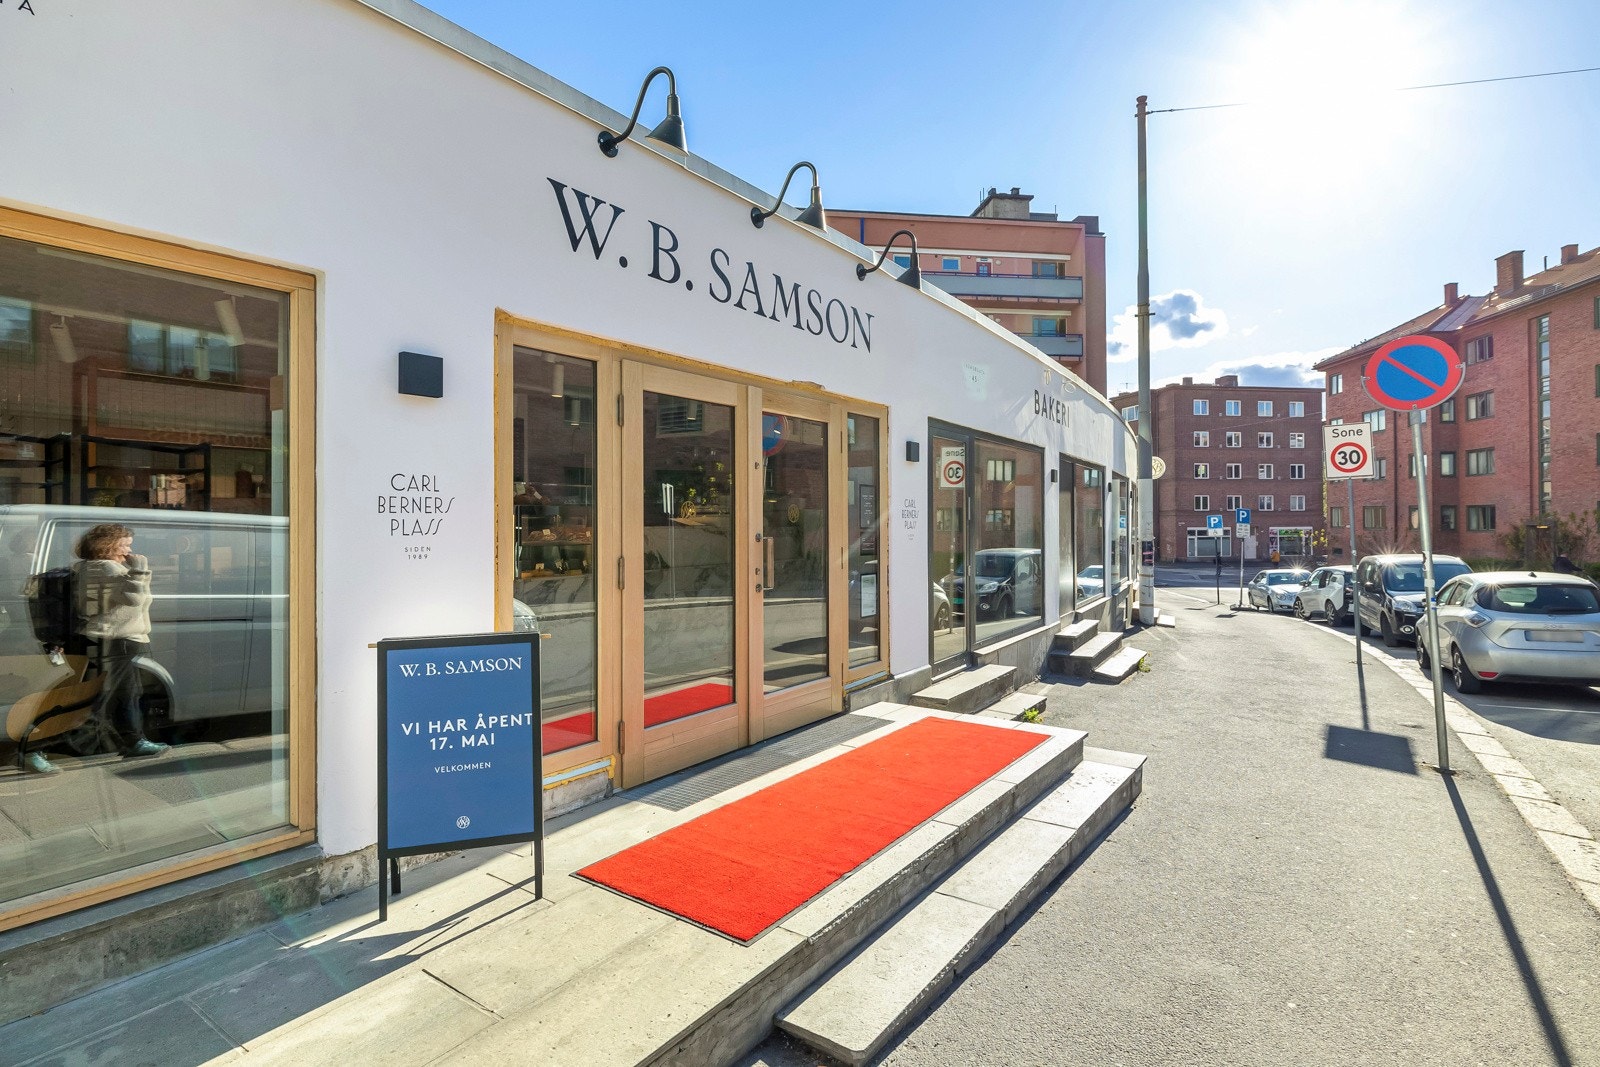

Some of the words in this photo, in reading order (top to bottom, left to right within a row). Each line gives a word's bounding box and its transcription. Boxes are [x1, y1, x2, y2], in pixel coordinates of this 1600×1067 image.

[547, 177, 628, 269] W.
[647, 220, 693, 291] B.
[708, 247, 875, 353] SAMSON
[1034, 389, 1070, 428] BAKERI
[1332, 427, 1363, 439] Sone
[1337, 449, 1361, 466] 30
[390, 473, 440, 492] CARL
[377, 495, 456, 514] BERNERS
[1211, 517, 1219, 527] P
[1239, 510, 1247, 522] P
[390, 518, 443, 537] PLASS
[399, 663, 421, 678] W.
[425, 661, 441, 677] B.
[445, 656, 522, 675] SAMSON
[401, 722, 420, 736] VI
[428, 717, 468, 734] HAR
[474, 712, 533, 730] ÅPENT
[429, 737, 453, 751] 17.
[461, 732, 495, 747] MAI
[434, 761, 492, 774] VELKOMMEN
